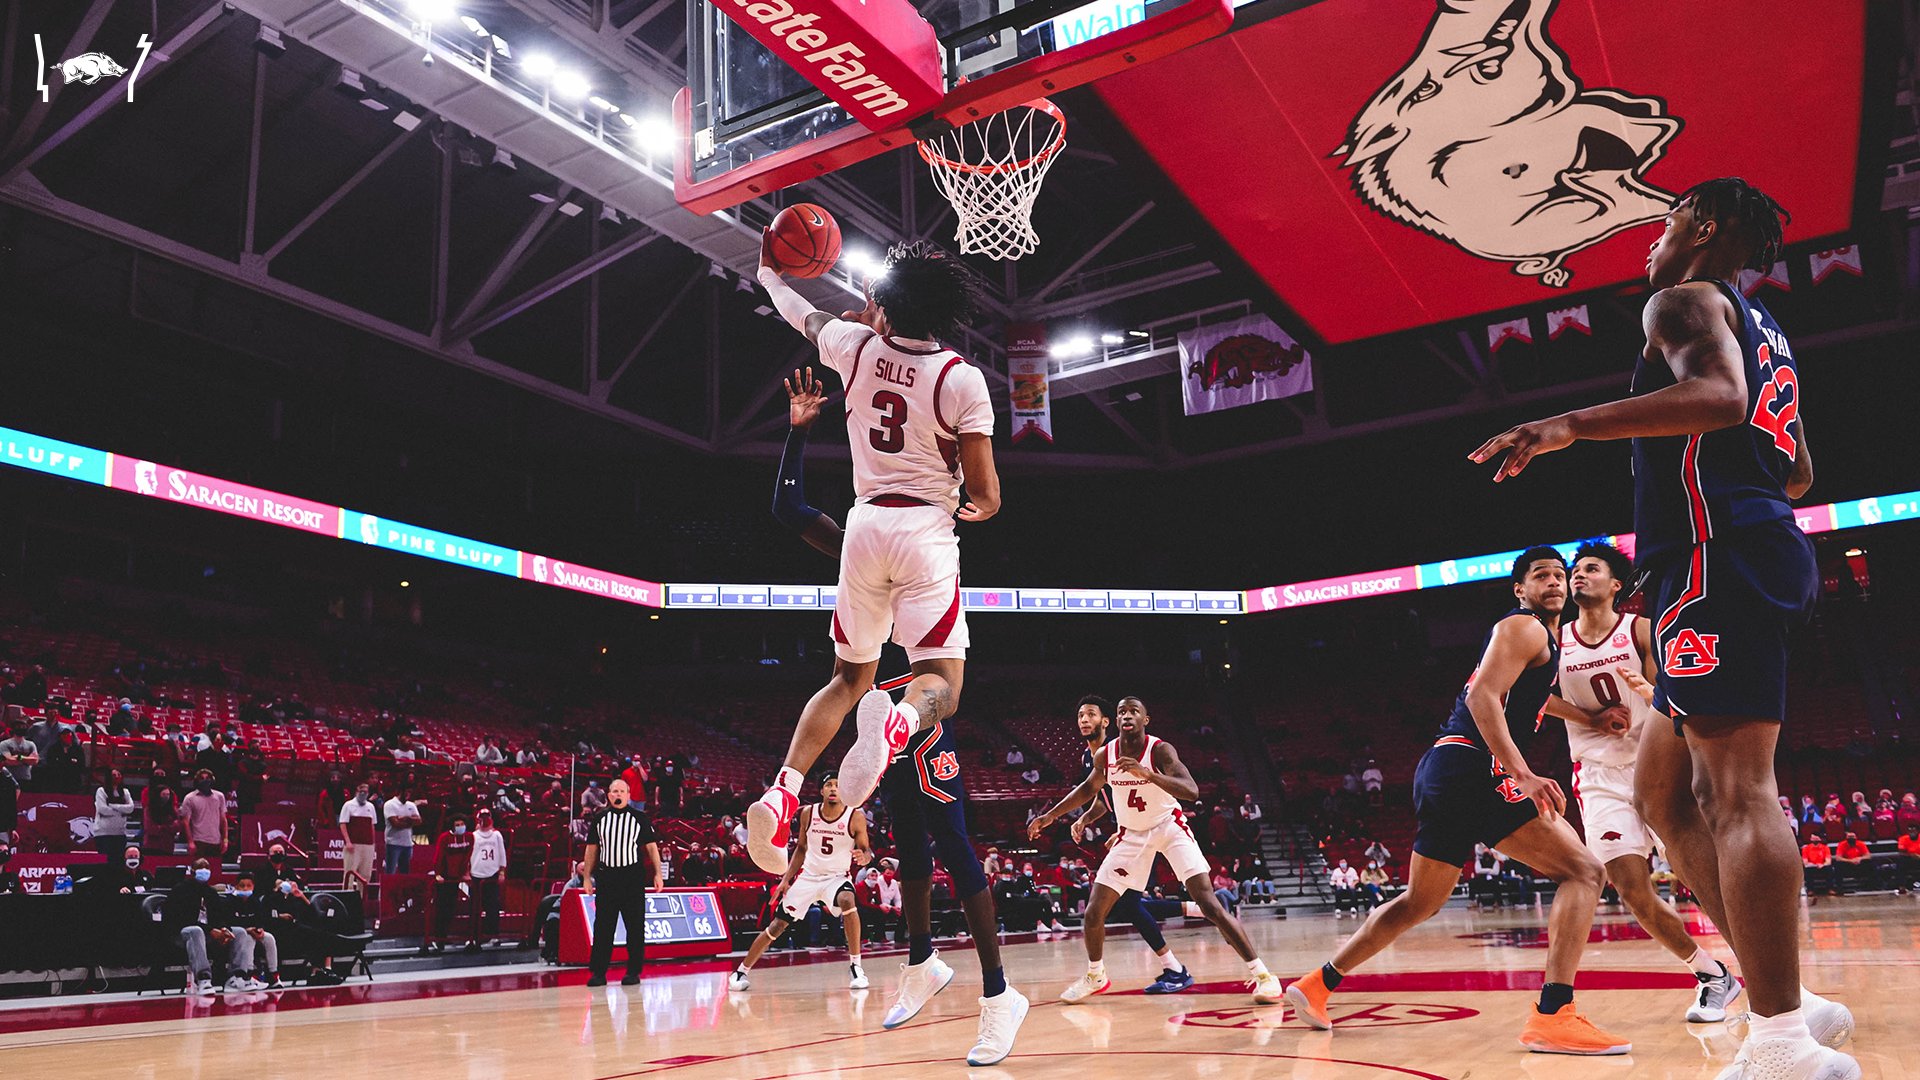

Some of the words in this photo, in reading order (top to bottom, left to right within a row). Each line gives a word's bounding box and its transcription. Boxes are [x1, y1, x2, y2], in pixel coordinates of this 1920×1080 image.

[875, 357, 916, 388] SILLS
[1750, 342, 1799, 462] 22
[869, 389, 908, 454] 3
[0, 440, 83, 471] LUFF
[168, 470, 258, 515] SARACEN
[263, 499, 324, 529] RESORT
[388, 530, 435, 552] PINE
[445, 543, 504, 567] BLUFF
[553, 562, 608, 593] SARACEN
[611, 581, 649, 602] RESORT
[1284, 582, 1348, 606] SARACEN
[1351, 576, 1402, 595] RESORT
[1566, 653, 1630, 673] RAZORBACKS
[1590, 672, 1621, 707] 0
[1127, 789, 1147, 812] 4
[481, 849, 495, 861] 34
[821, 836, 834, 855] 5
[693, 917, 713, 935] 66
